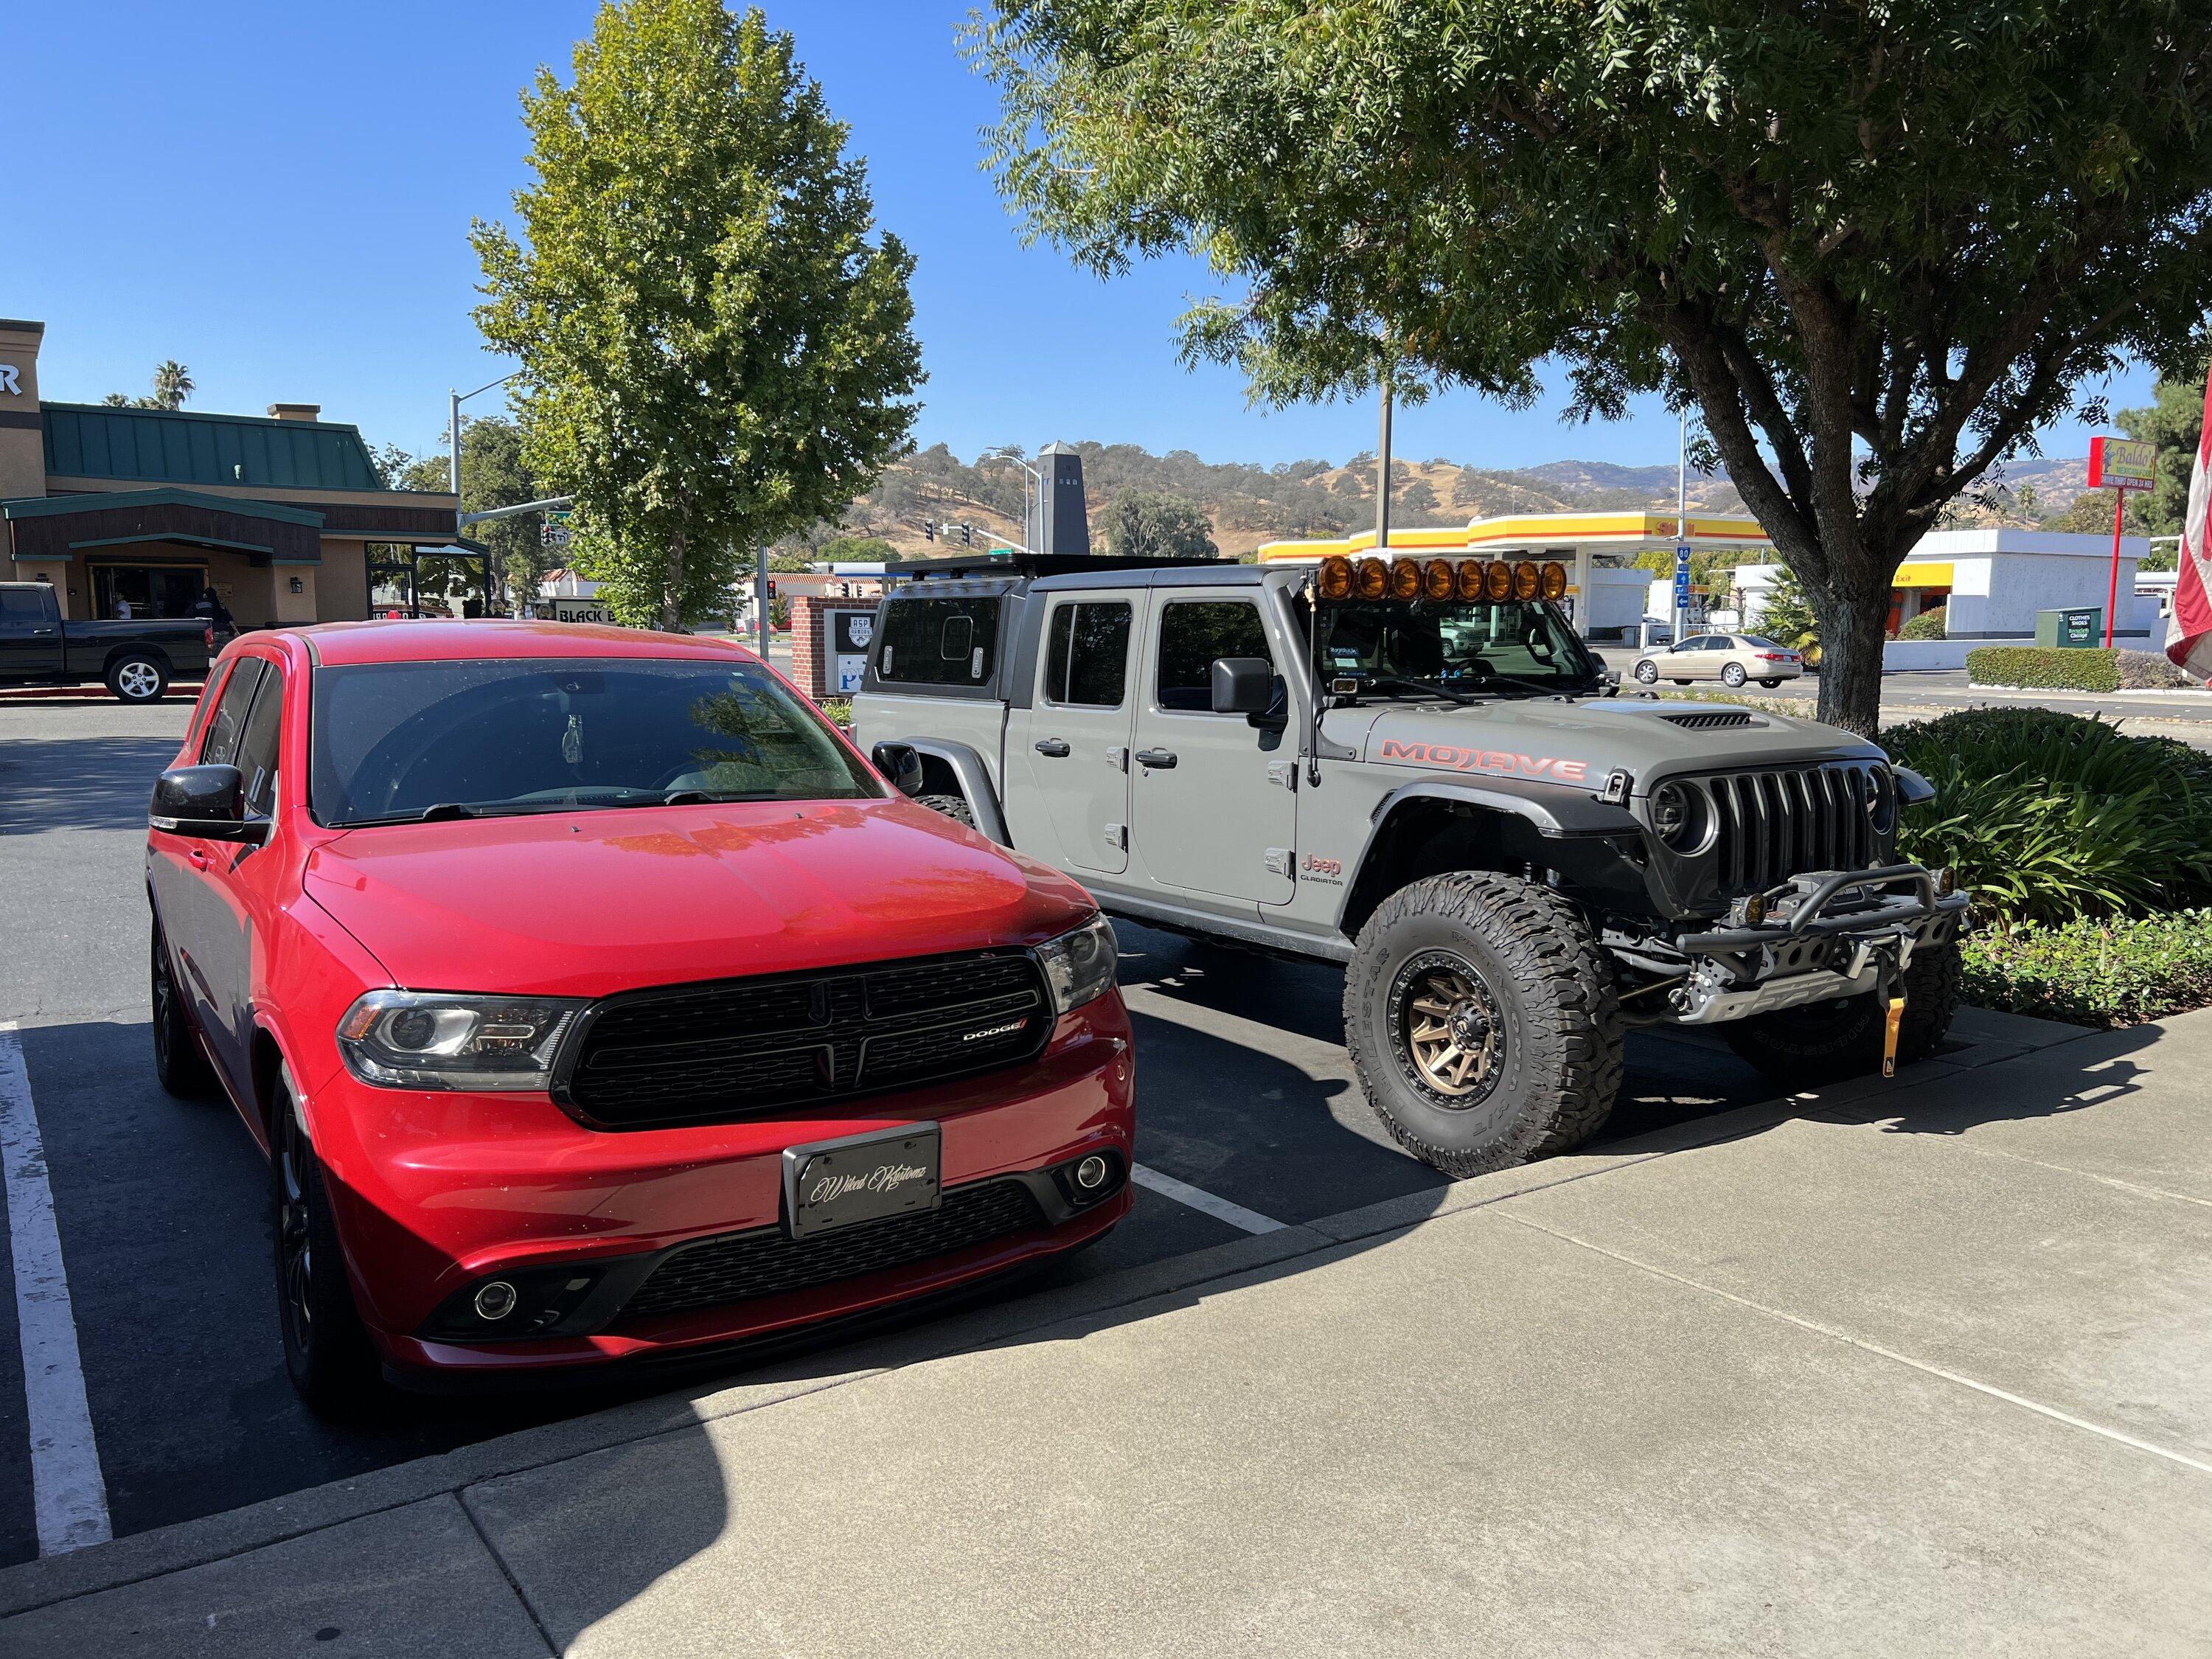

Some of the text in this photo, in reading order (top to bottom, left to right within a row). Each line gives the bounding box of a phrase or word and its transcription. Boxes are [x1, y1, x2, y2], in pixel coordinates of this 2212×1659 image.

[2126, 478, 2138, 487] OPEN
[2138, 479, 2143, 487] 24
[1658, 521, 1695, 537] Shll
[1679, 549, 1688, 558] 80
[560, 611, 602, 623] BLACK
[853, 619, 868, 627] ASP
[1380, 739, 1589, 782] MOJAVE
[1301, 853, 1341, 877] Jeep
[1300, 874, 1343, 886] GLADIATOR
[963, 1022, 1021, 1041] DODGE
